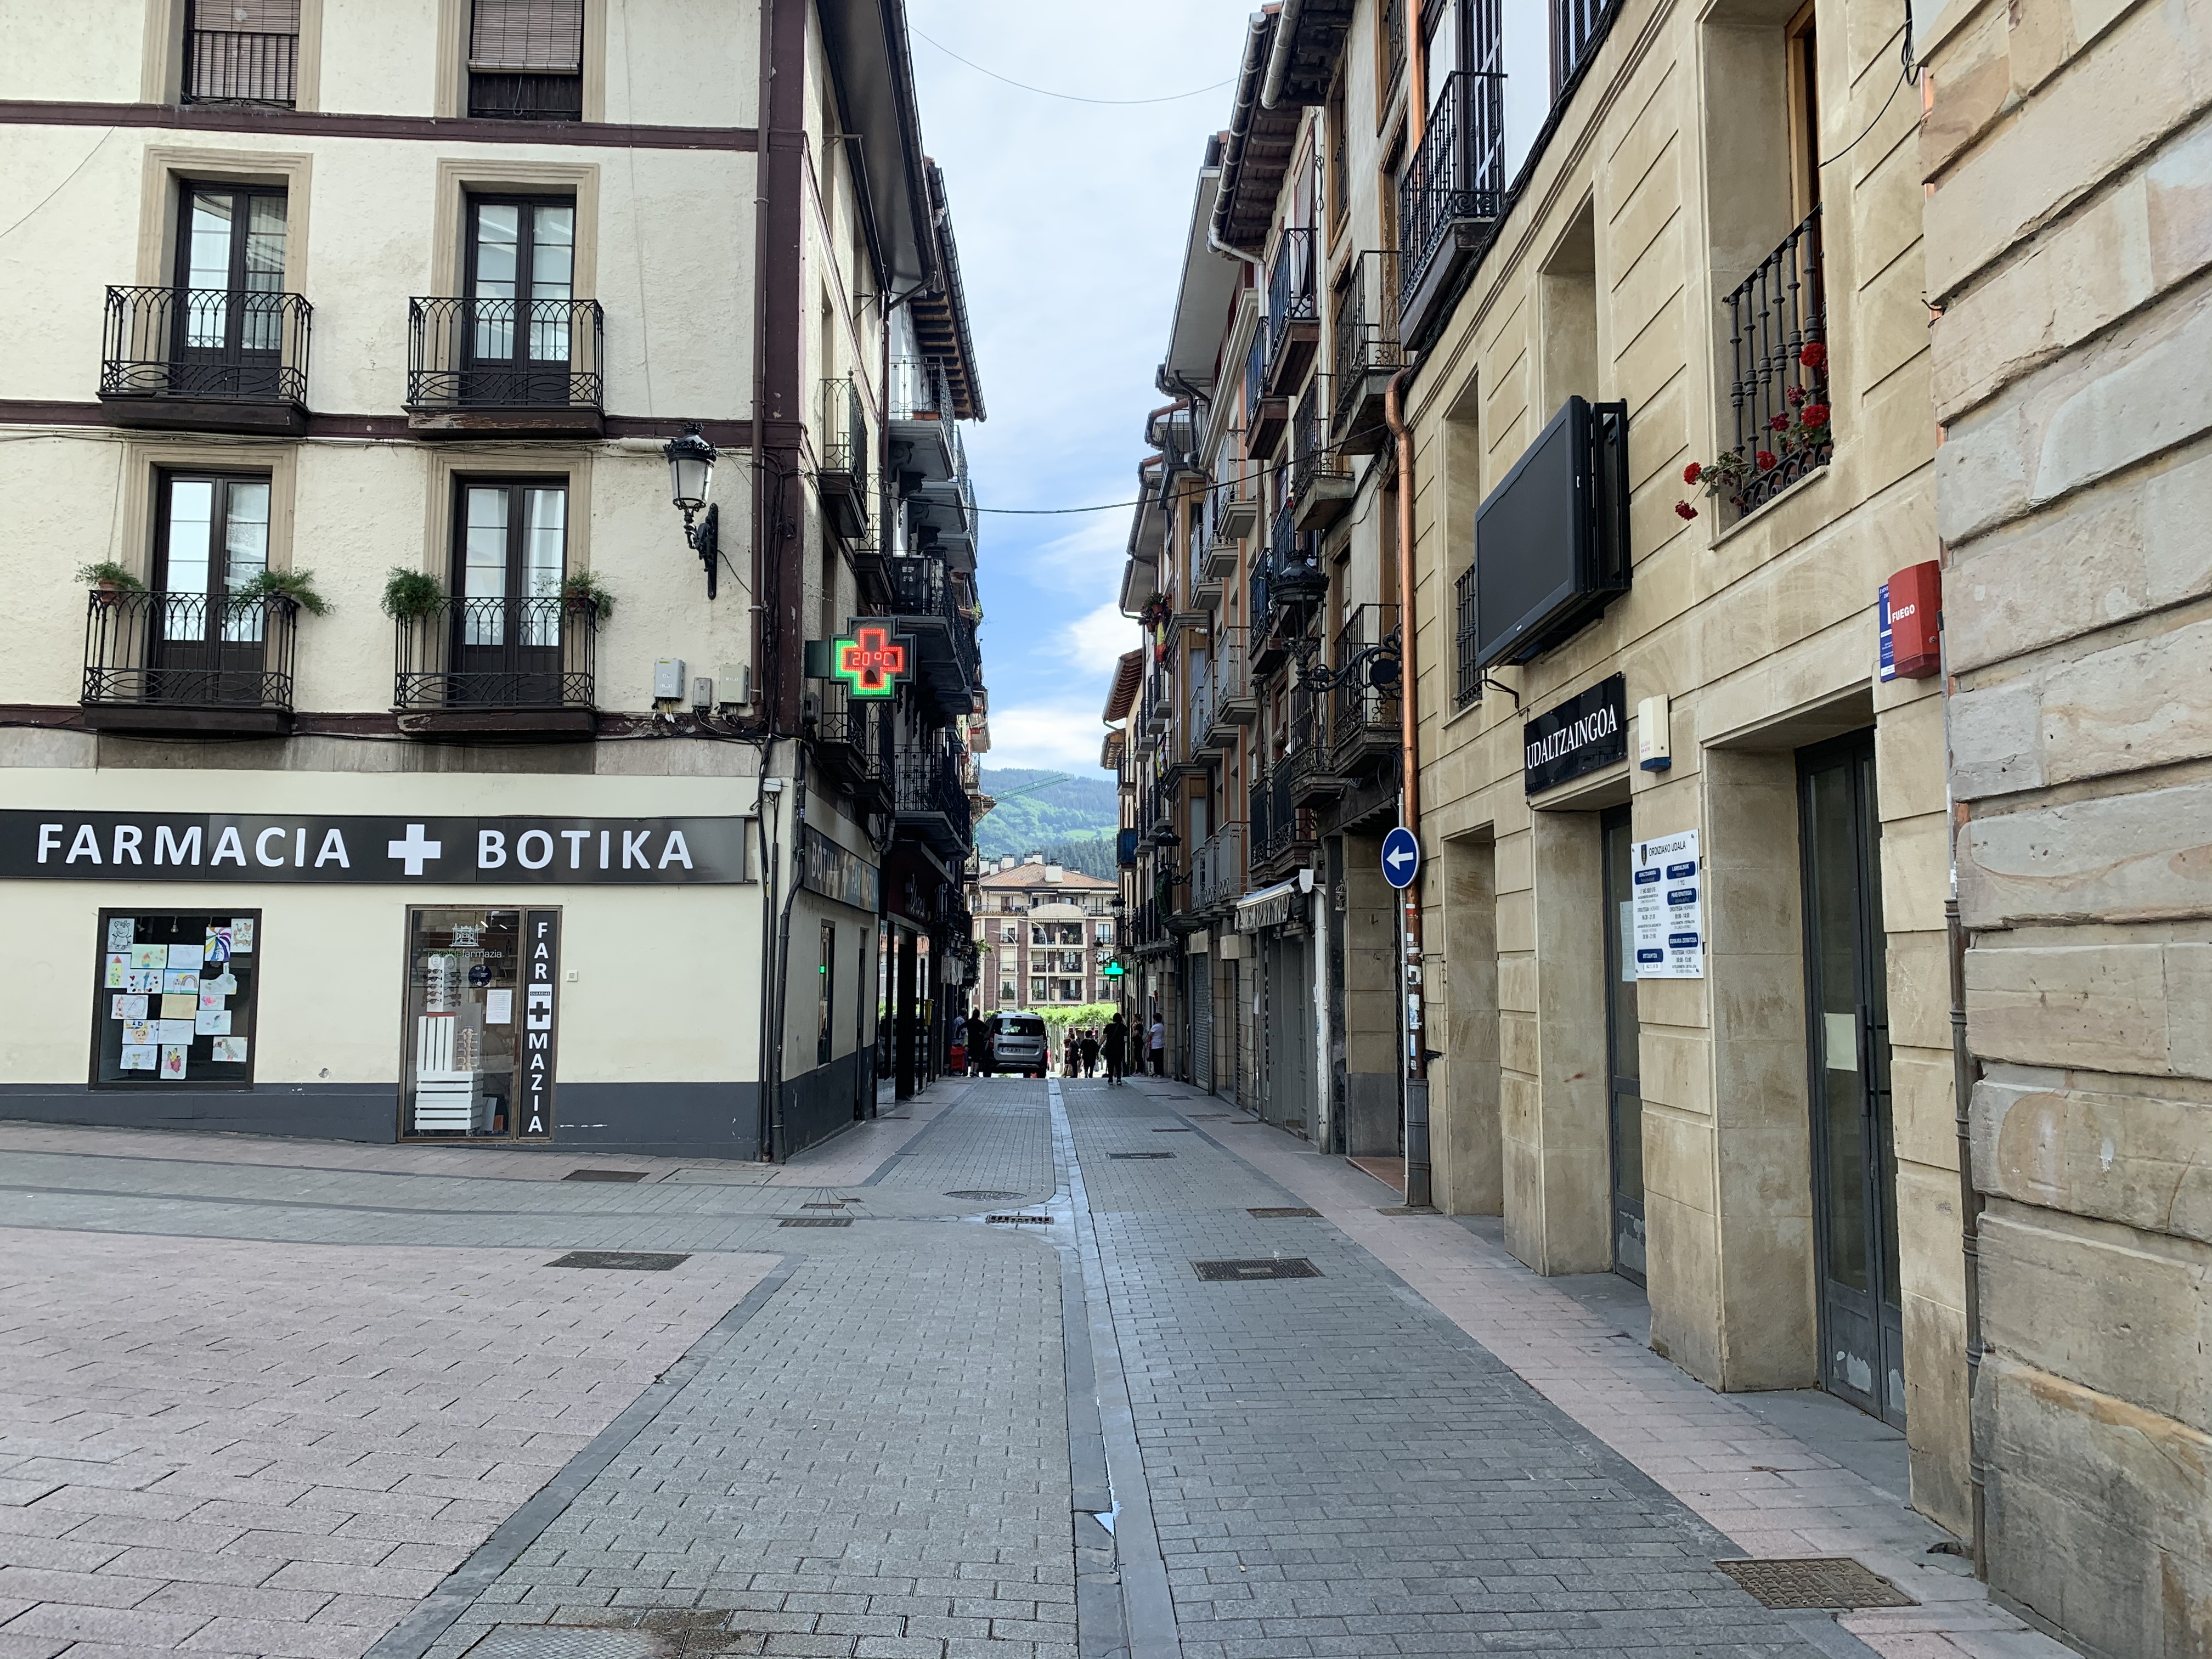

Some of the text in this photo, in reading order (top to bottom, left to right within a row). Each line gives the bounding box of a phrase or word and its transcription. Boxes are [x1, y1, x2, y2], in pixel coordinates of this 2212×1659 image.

[1892, 604, 1915, 623] FUEGO
[1526, 704, 1617, 769] UDALTZAINGOA
[37, 824, 351, 868] FARMACIA
[478, 830, 693, 870] BOTIKA
[811, 842, 838, 887] BOTIKA
[1649, 840, 1686, 856] ORDIZIAKO UDALA
